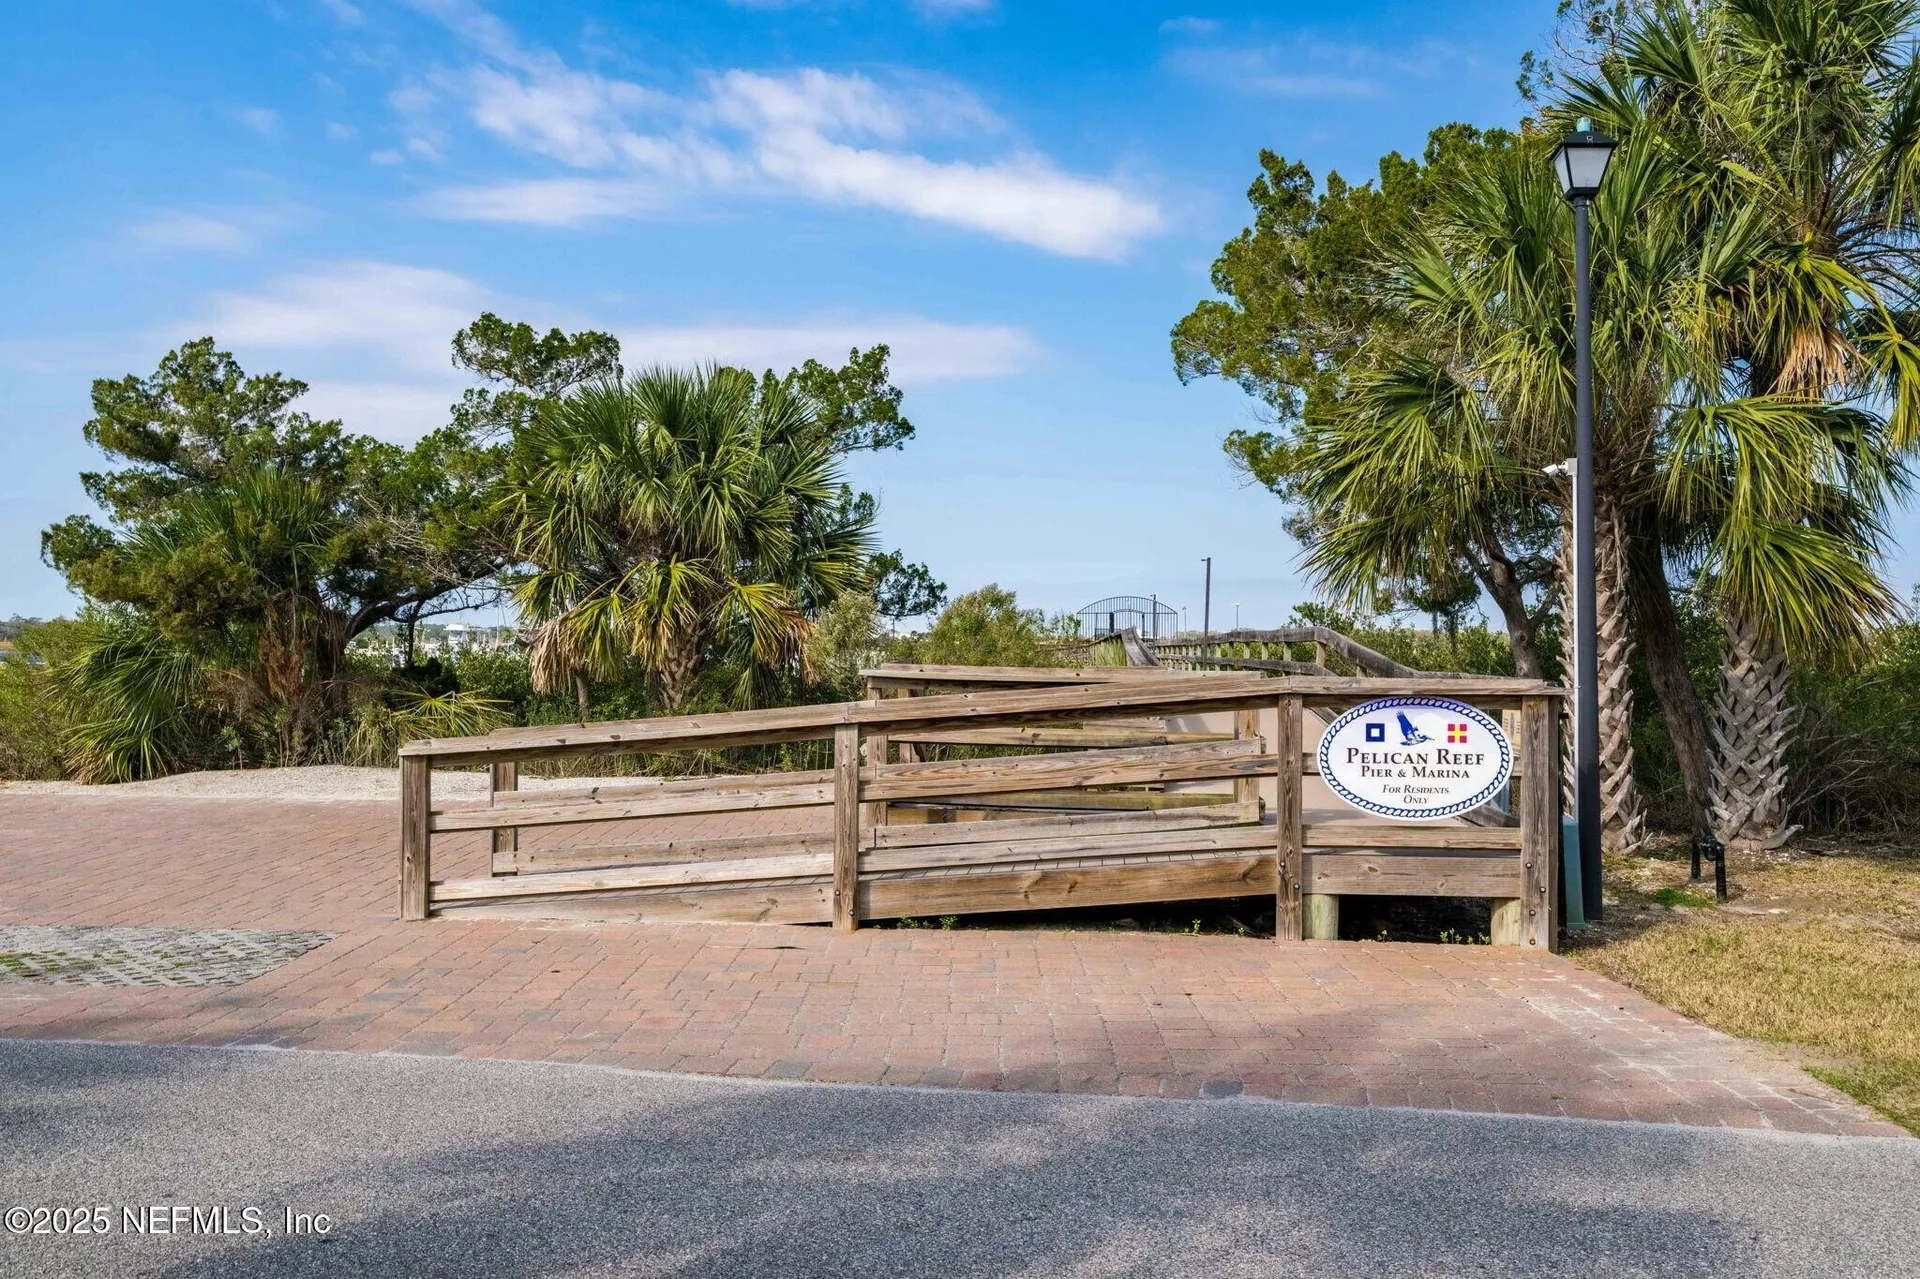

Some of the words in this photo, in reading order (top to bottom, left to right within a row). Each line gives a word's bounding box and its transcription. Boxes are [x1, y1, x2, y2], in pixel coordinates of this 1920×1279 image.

[1346, 747, 1428, 763] PELICAN
[1436, 748, 1485, 764] REEF
[1361, 765, 1393, 777] PIER
[1397, 768, 1406, 778] &
[1412, 766, 1470, 779] MARINA
[1382, 784, 1401, 793] FOR
[1403, 784, 1449, 794] RESIDENTS
[1403, 794, 1429, 804] ONLY
